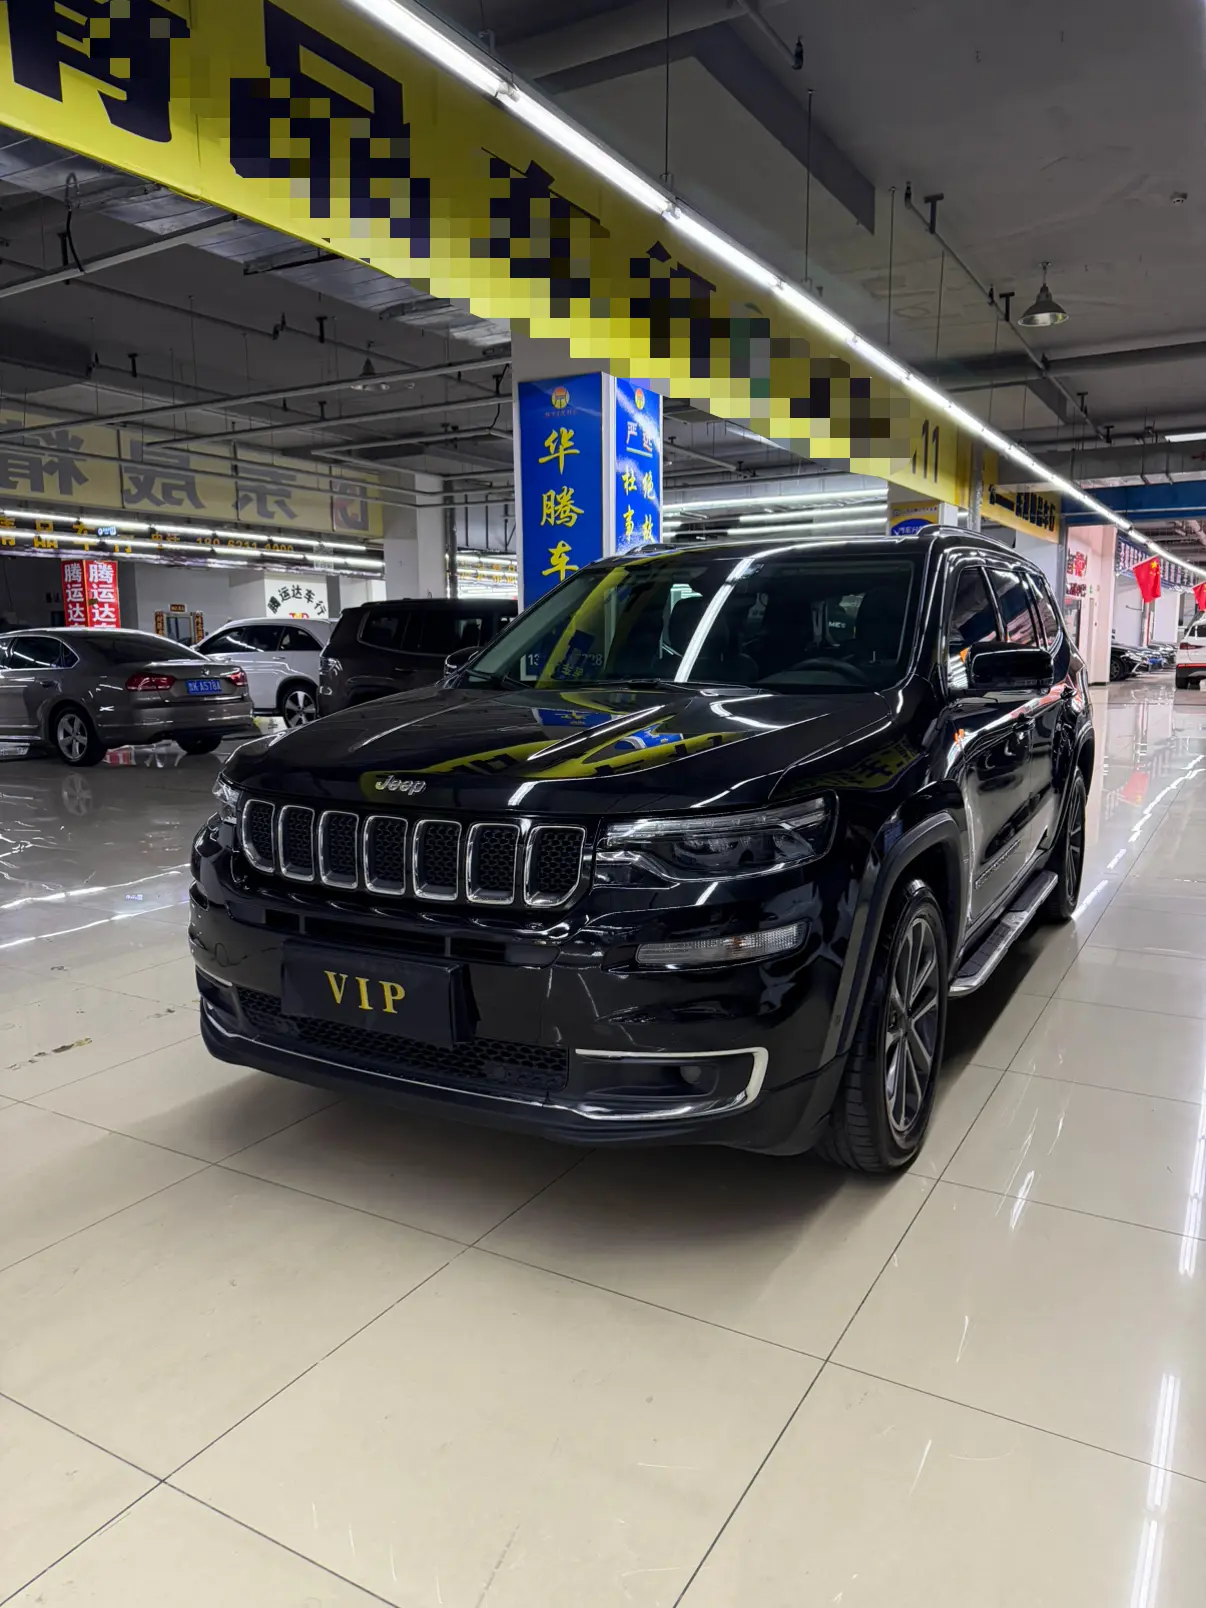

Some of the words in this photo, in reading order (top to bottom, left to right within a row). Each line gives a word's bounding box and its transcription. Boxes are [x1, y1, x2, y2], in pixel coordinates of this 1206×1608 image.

[538, 427, 585, 581] 华腾车
[64, 563, 86, 628] 腾运达
[375, 775, 427, 796] Jeep
[324, 970, 406, 1014] VIP
